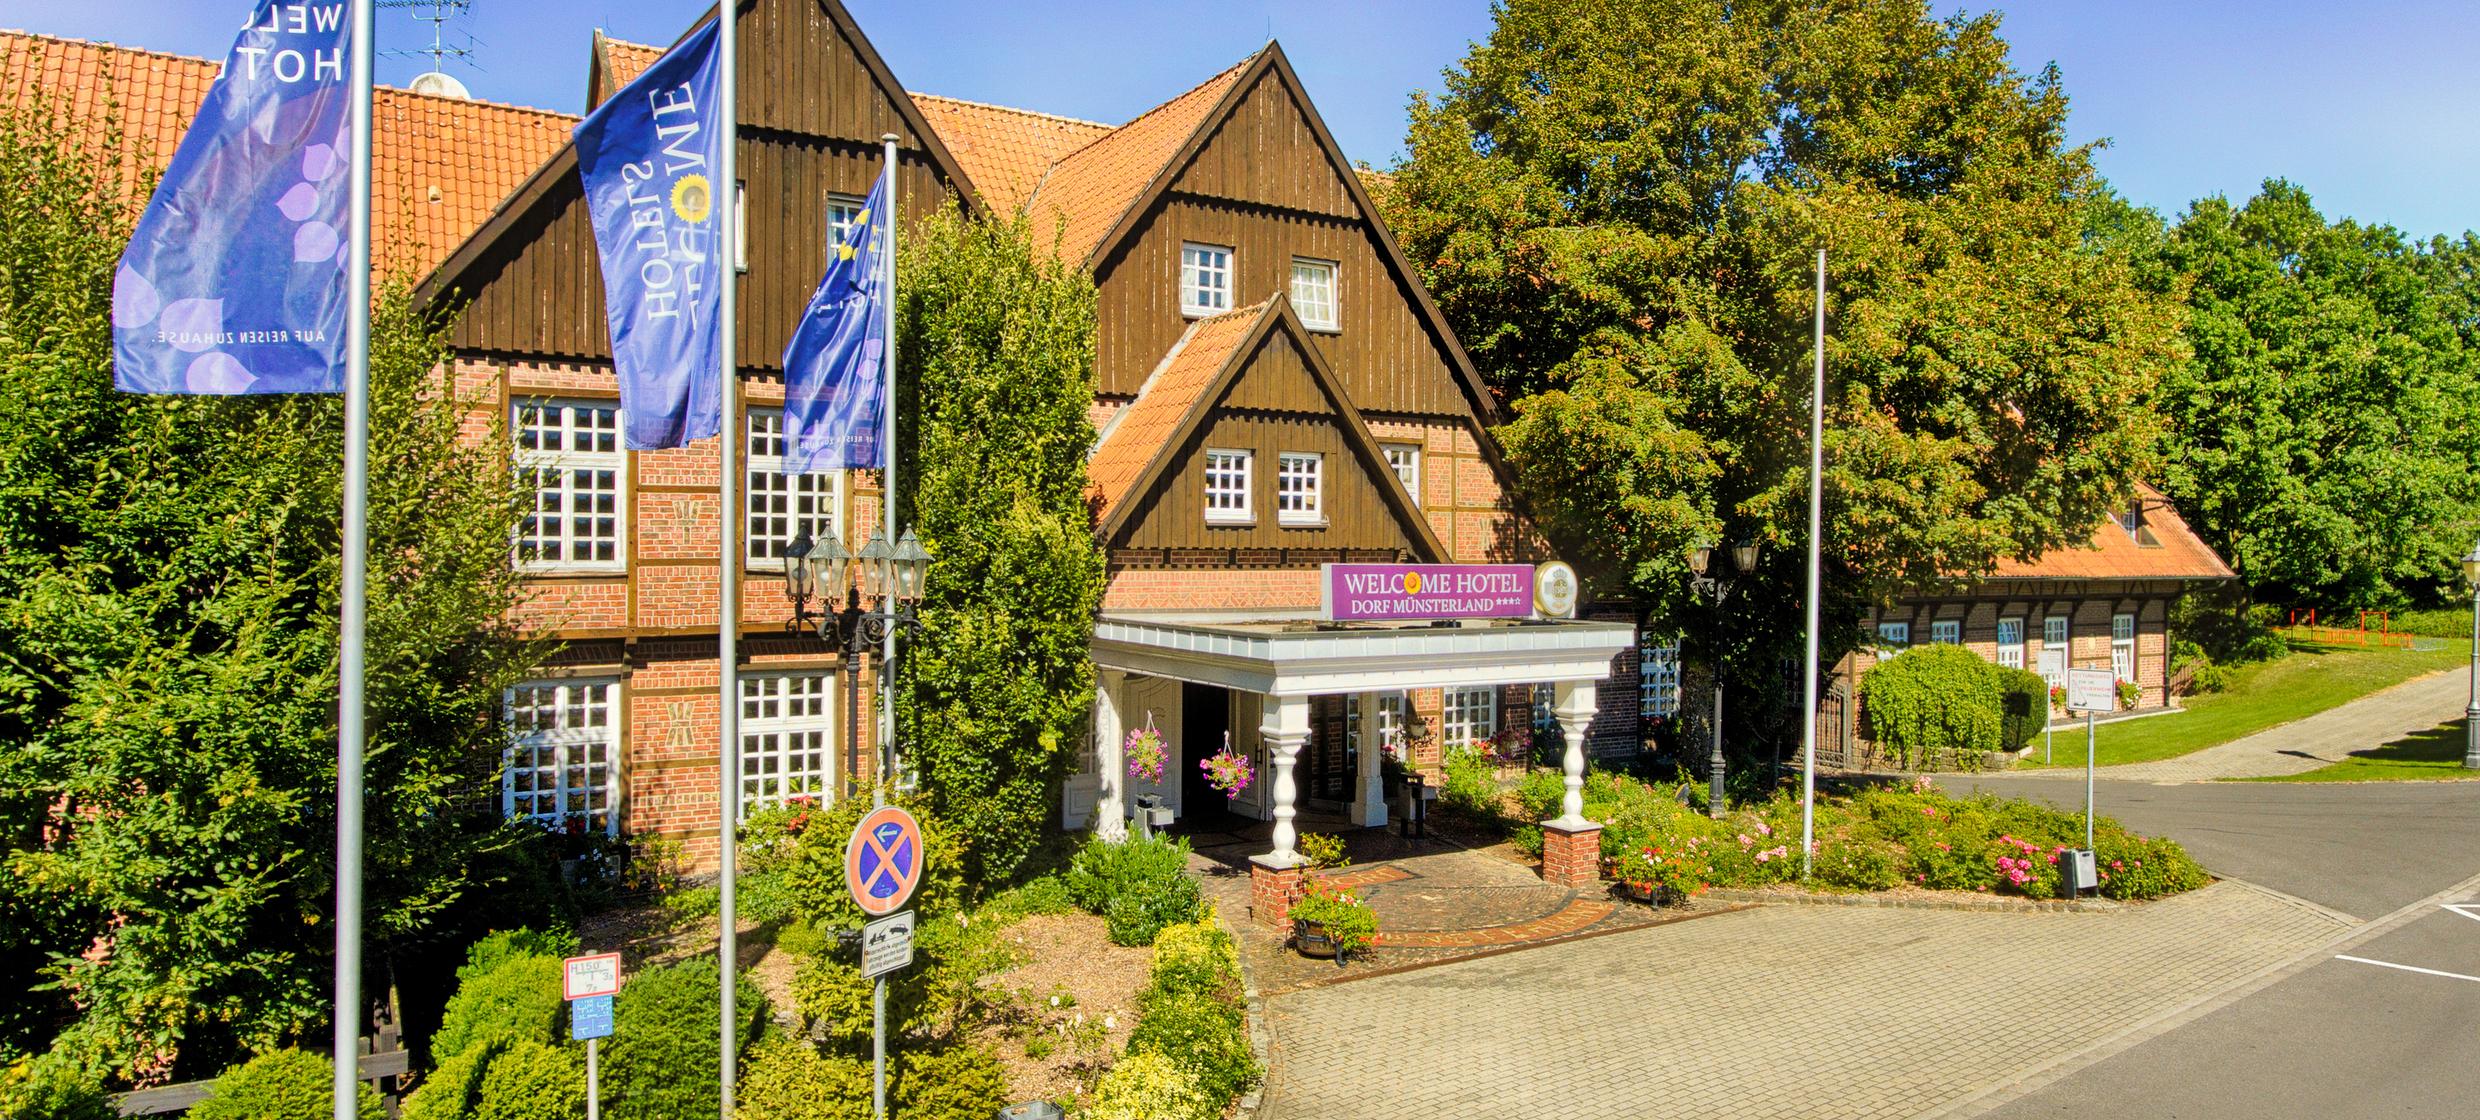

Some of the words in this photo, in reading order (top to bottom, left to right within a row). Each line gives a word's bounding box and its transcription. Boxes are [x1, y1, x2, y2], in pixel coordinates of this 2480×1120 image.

[1456, 573, 1523, 593] HOTEL
[1351, 599, 1391, 614] DORF
[1393, 596, 1494, 613] MÜNSTERLAND
